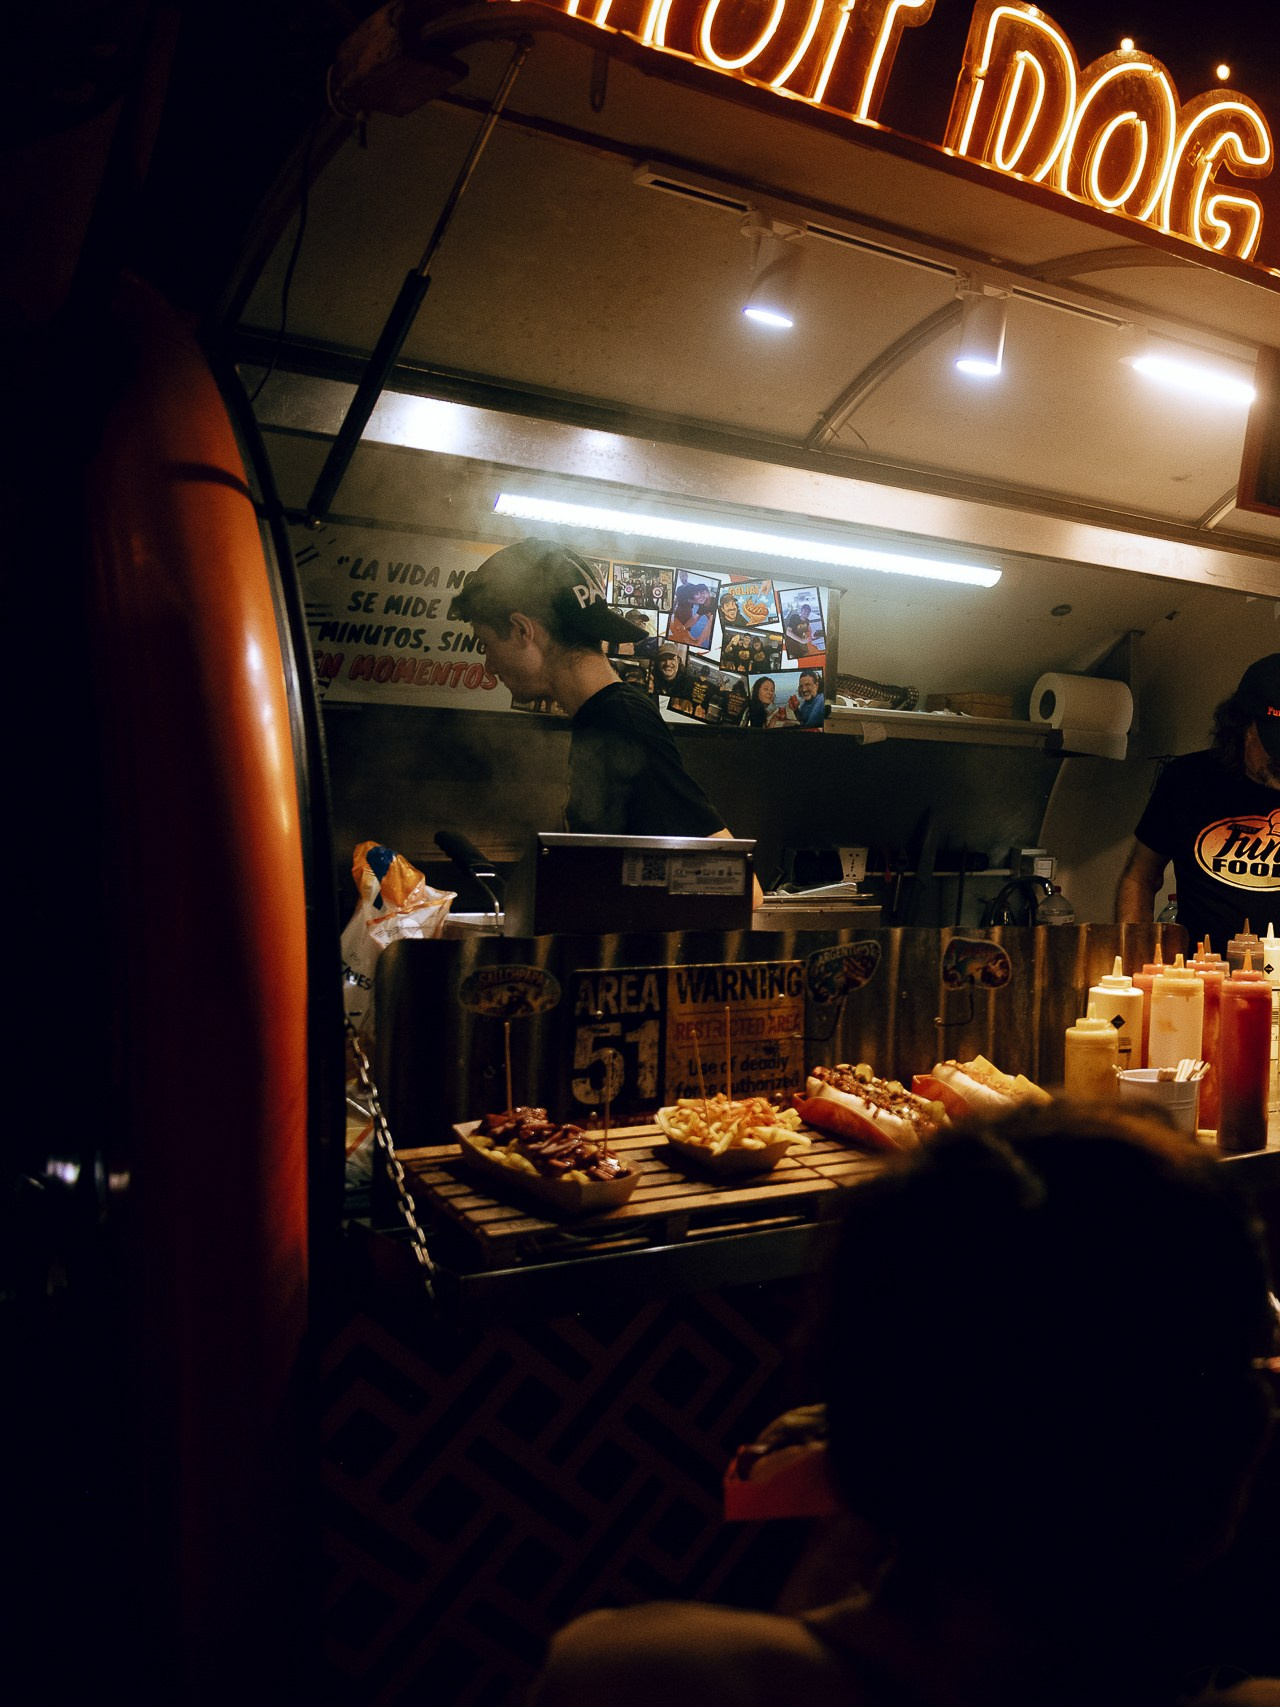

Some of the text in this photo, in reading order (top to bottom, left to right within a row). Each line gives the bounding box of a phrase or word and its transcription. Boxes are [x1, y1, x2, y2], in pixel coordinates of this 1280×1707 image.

[945, 3, 1273, 262] DOG
[387, 562, 440, 589] VIDA
[347, 591, 379, 613] SE
[383, 595, 442, 620] MIDE
[318, 621, 431, 653] MINUTOS,
[348, 654, 498, 691] MOMENTOS
[573, 963, 804, 1018] AREA WARNING
[571, 1019, 661, 1106] 51
[767, 1014, 801, 1036] AREA
[688, 1059, 717, 1077] Use
[741, 1055, 789, 1073] deadly
